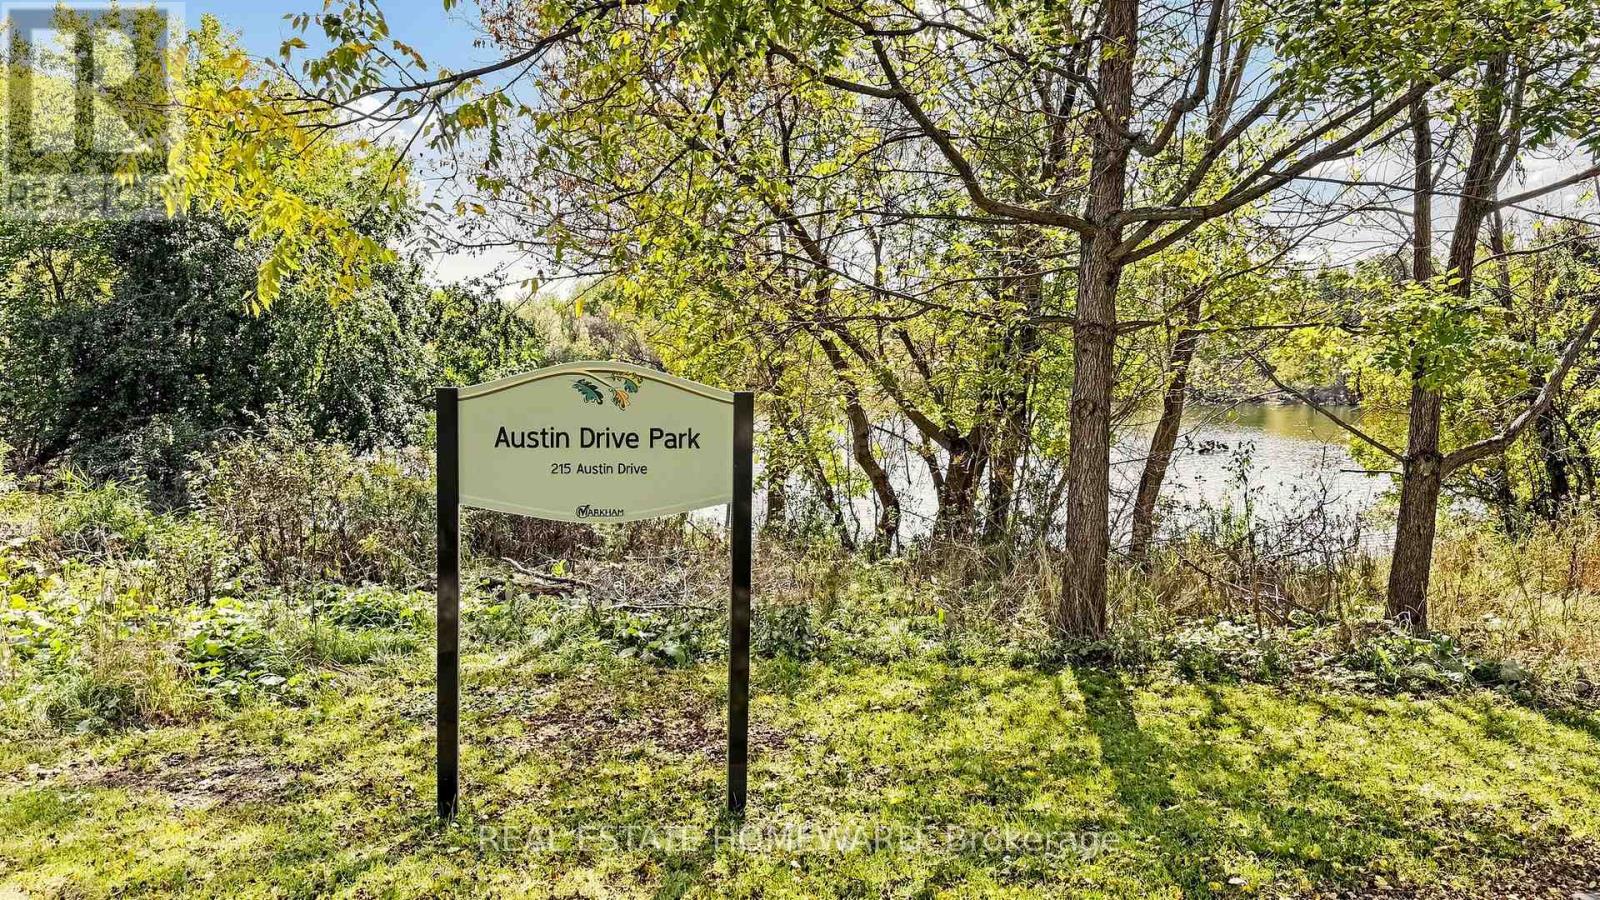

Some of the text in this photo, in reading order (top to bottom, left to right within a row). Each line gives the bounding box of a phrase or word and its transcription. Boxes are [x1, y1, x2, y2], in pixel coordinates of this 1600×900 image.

[494, 426, 701, 450] Austin Drive Park
[550, 462, 648, 476] 215 Austin Drive
[575, 504, 625, 519] MARKHAM
